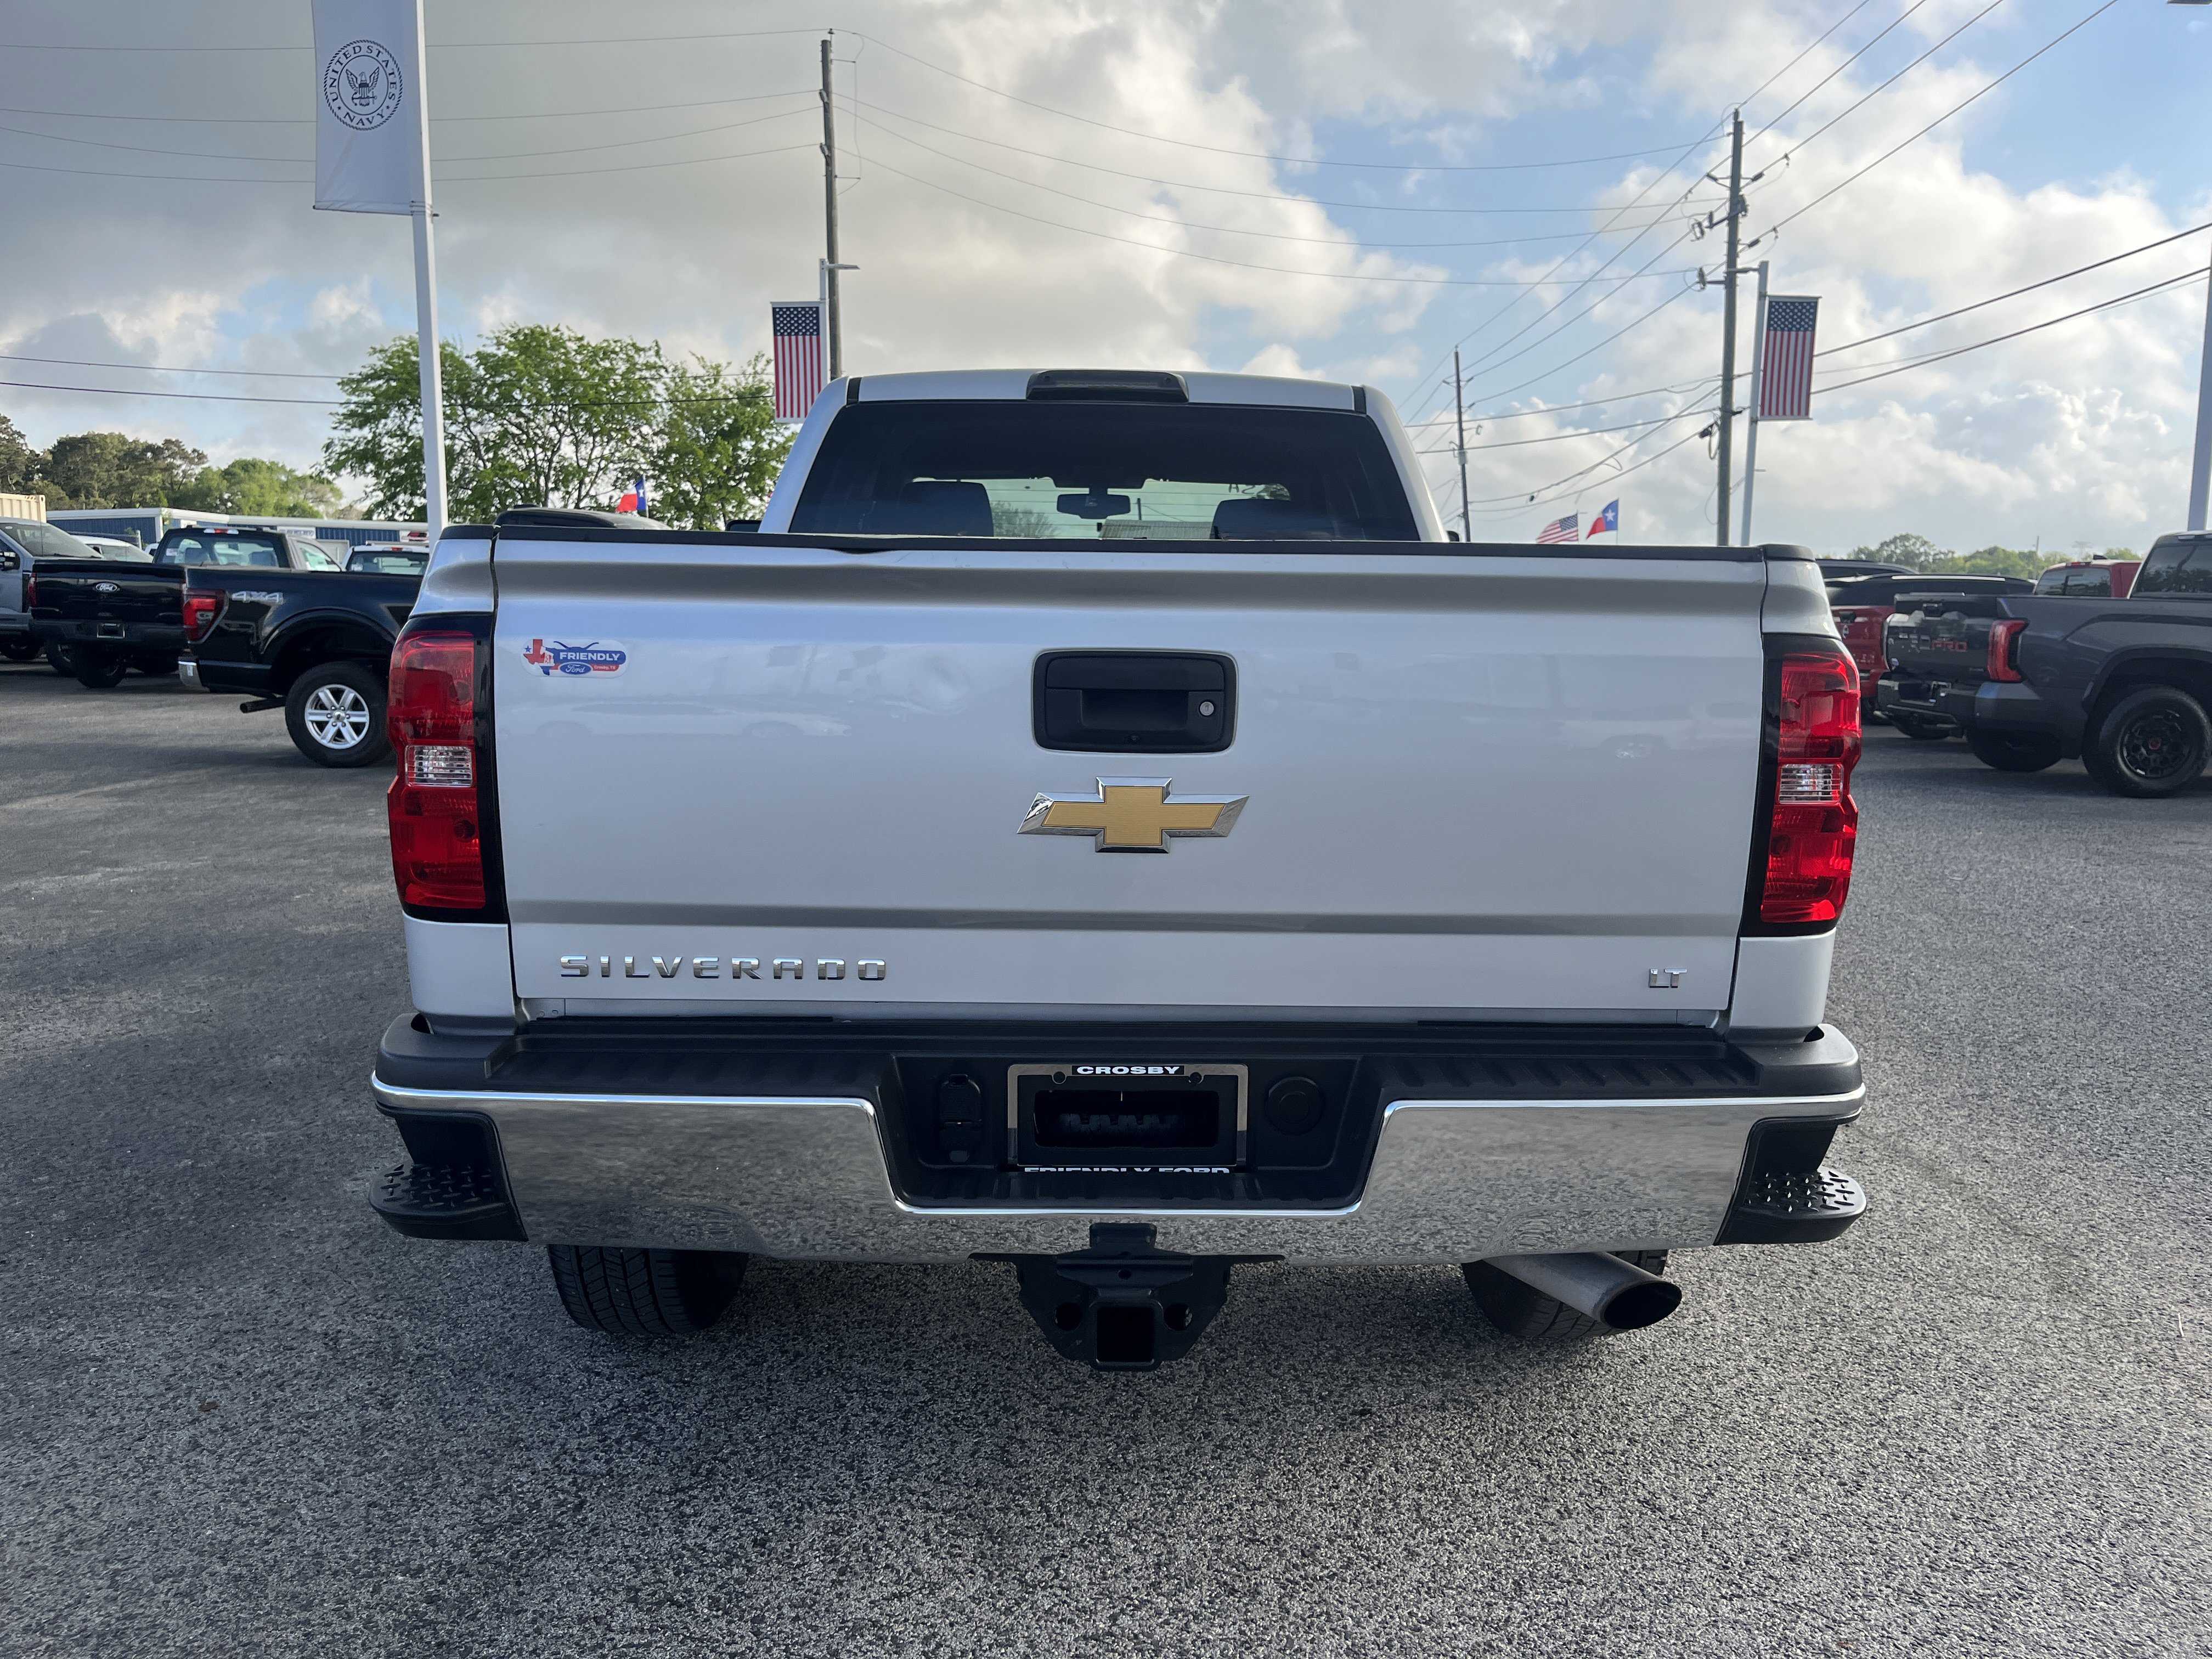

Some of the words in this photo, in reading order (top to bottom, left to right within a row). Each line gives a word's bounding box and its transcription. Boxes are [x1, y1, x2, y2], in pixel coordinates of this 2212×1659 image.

[329, 46, 362, 103] UNITED
[366, 45, 397, 101] STATES
[343, 108, 385, 126] NAVY
[560, 652, 620, 661] FRIENDLY
[565, 664, 585, 673] Ford
[561, 955, 886, 981] SILVERADO
[1649, 969, 1687, 988] LT
[1077, 1066, 1180, 1074] CROSBY
